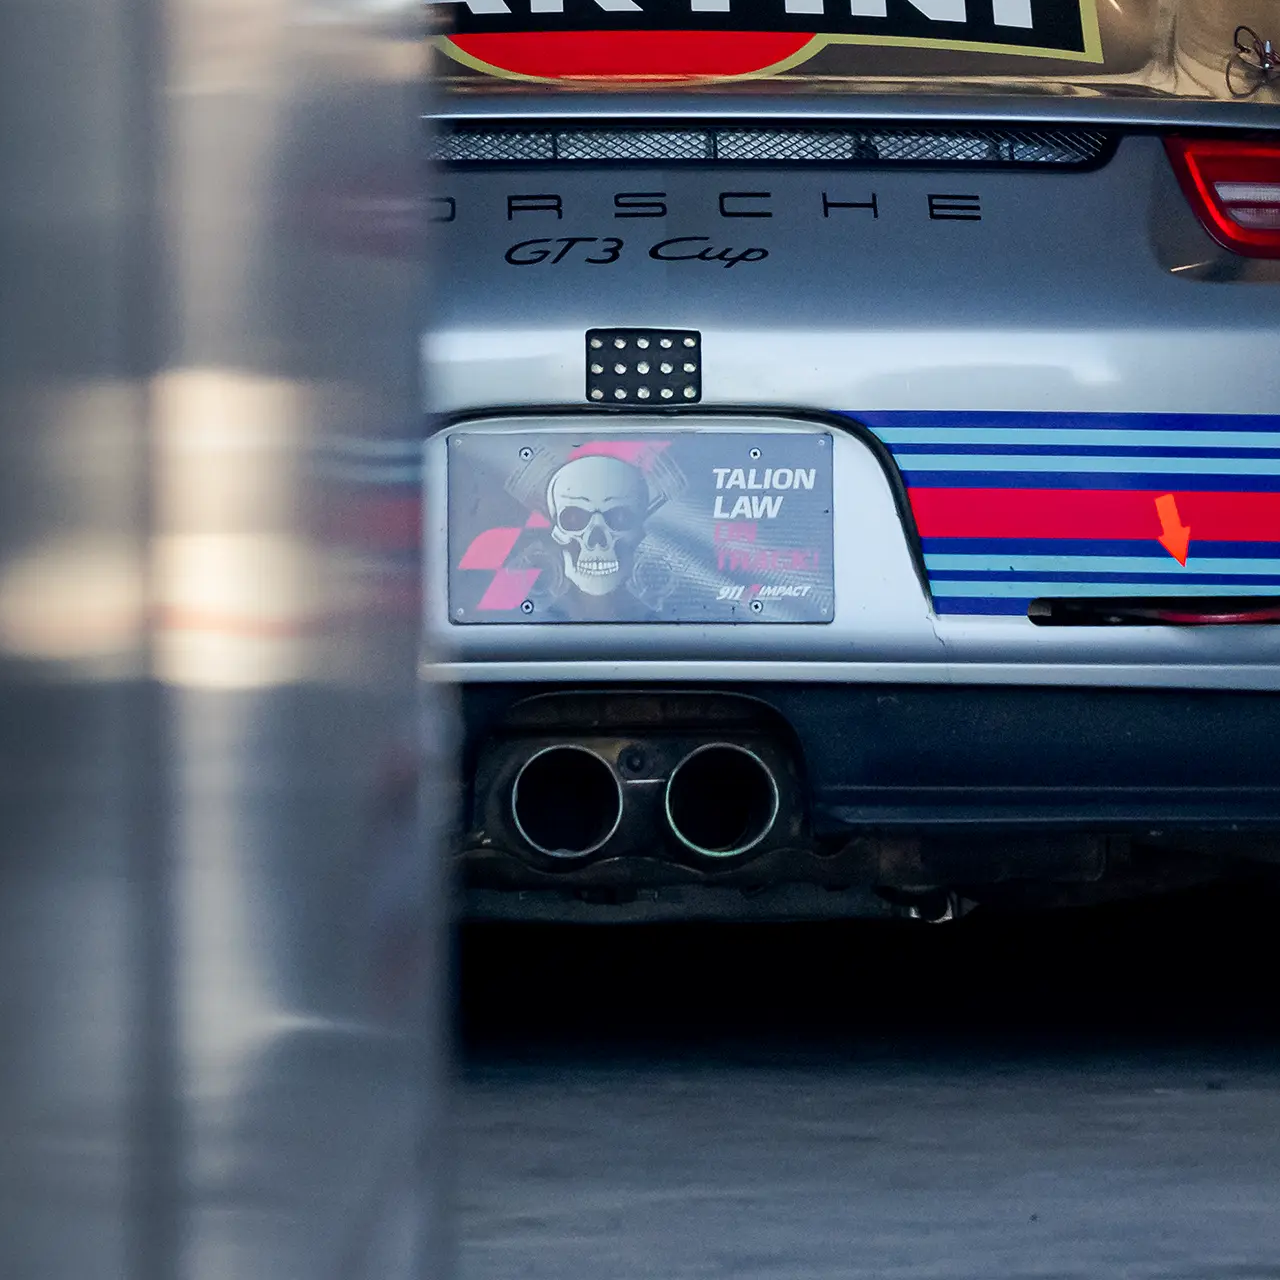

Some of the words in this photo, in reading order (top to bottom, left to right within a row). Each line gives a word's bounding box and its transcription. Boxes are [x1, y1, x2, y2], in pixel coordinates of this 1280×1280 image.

[426, 192, 982, 222] ORSCHE
[504, 237, 624, 266] GT3
[647, 236, 770, 268] Cup
[712, 468, 817, 491] TALION
[713, 495, 784, 519] LAW
[716, 585, 746, 601] 911
[758, 585, 812, 597] IMPACT
